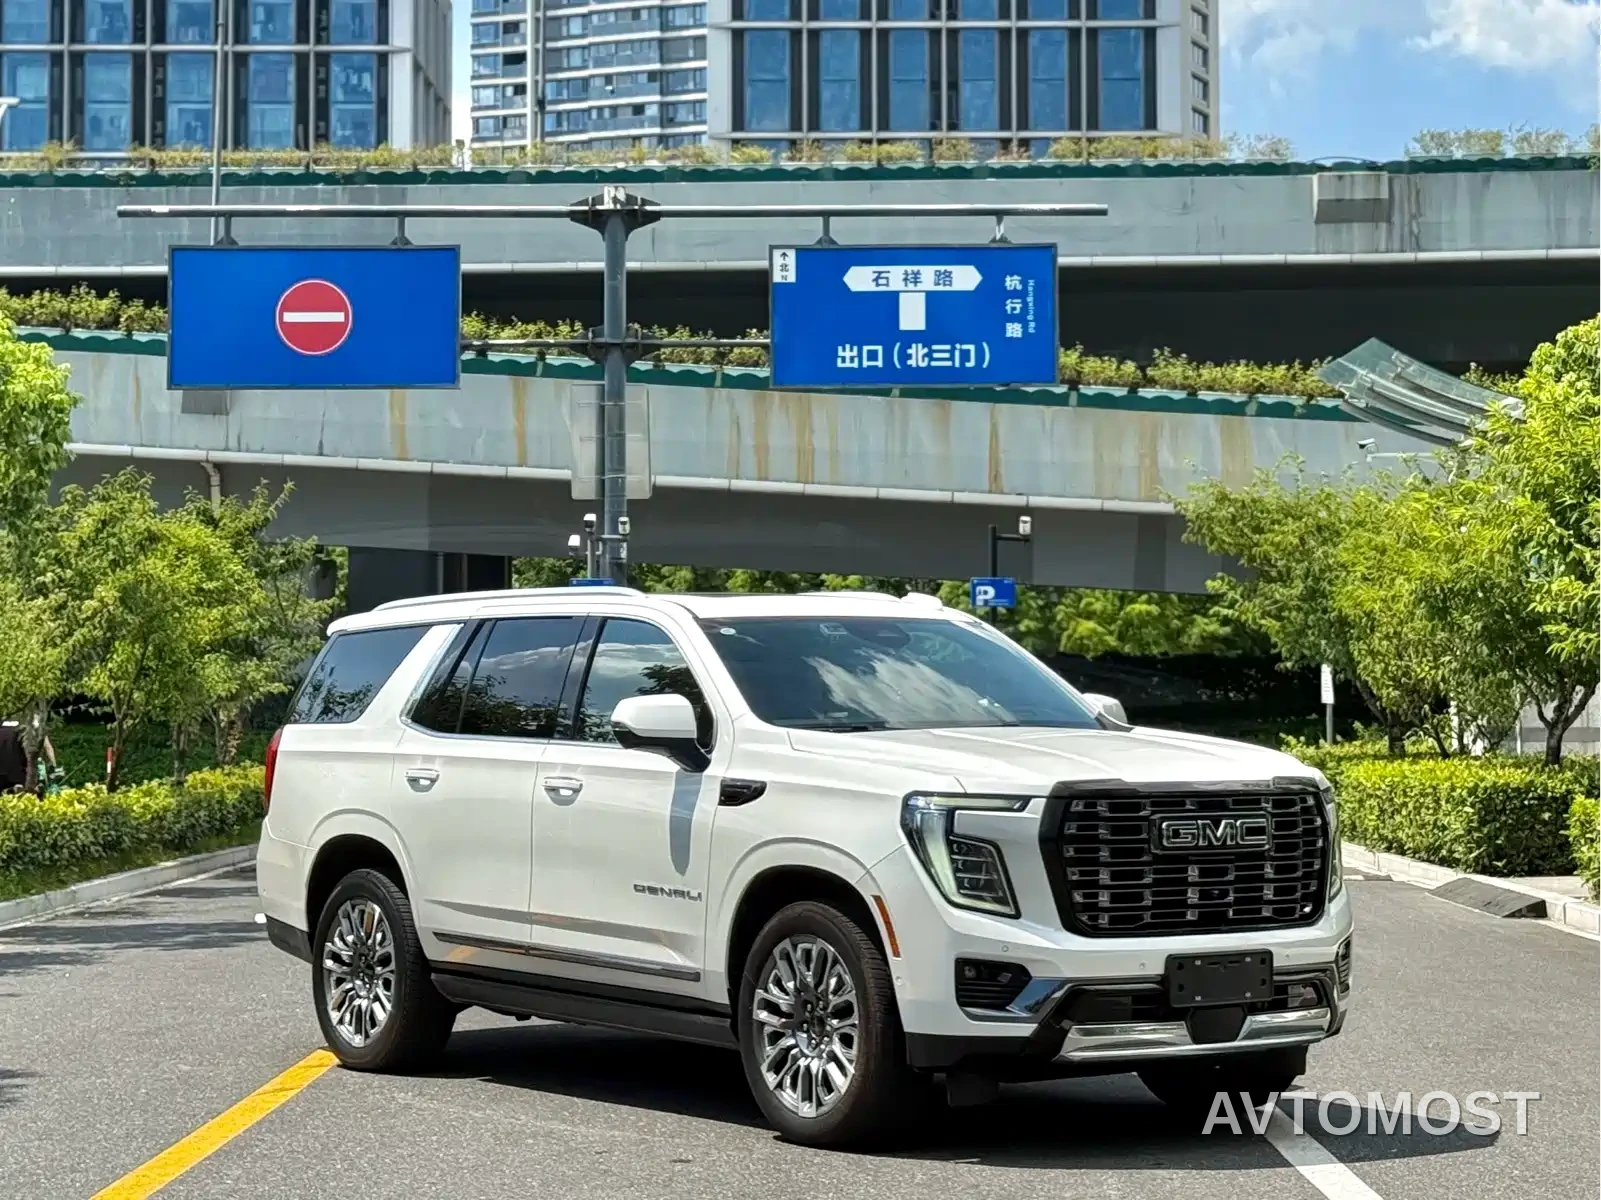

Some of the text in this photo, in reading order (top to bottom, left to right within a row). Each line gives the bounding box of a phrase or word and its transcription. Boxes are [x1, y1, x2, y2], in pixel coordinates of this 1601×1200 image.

[779, 263, 790, 272] 北
[871, 269, 954, 288] 石祥路
[1004, 274, 1023, 338] 杭行路
[1026, 279, 1036, 333] Hangxing Rd
[836, 341, 991, 369] 出口（北三门）
[1162, 819, 1267, 847] GMC
[633, 883, 703, 902] DENALI
